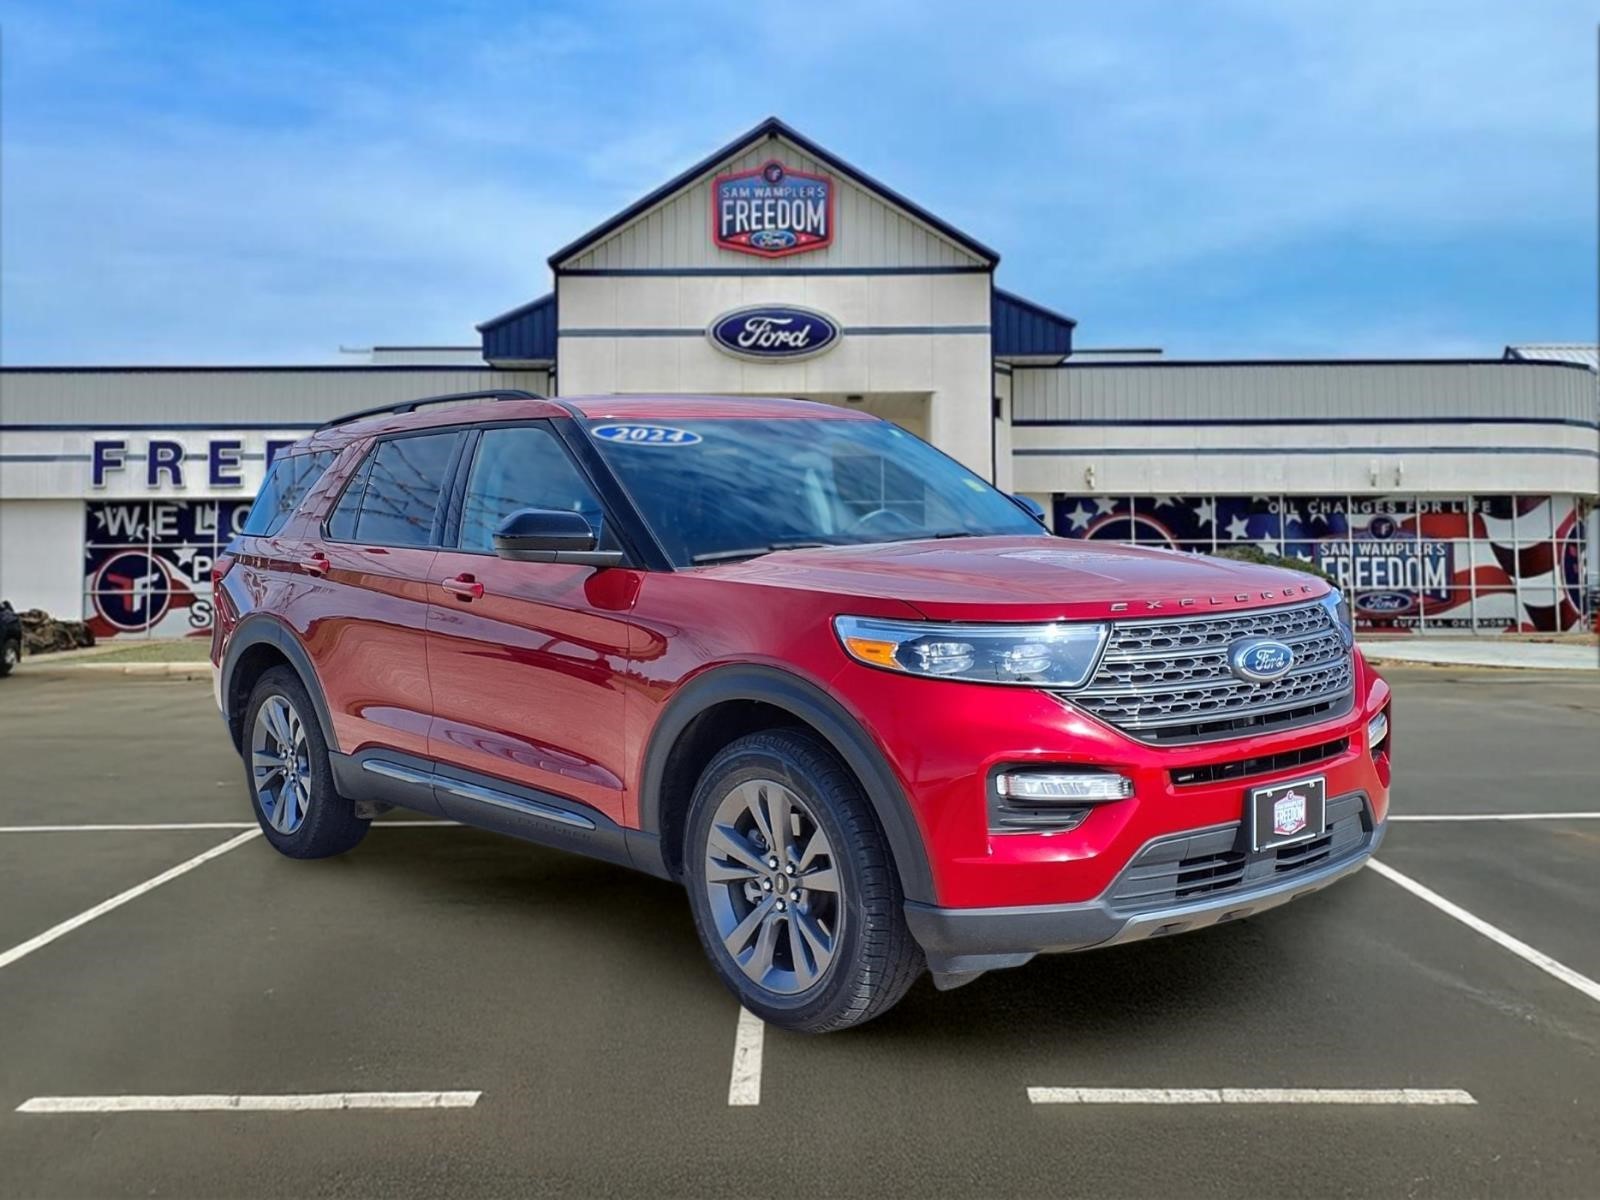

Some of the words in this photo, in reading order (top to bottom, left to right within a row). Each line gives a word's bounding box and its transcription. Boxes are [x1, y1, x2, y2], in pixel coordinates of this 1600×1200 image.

[722, 187, 750, 198] SAM
[721, 200, 826, 236] FREEDOM
[738, 317, 811, 347] Ford
[611, 428, 684, 442] 2024
[1268, 502, 1299, 514] OIL
[1307, 502, 1397, 514] CHANGES
[1405, 502, 1443, 514] FOR
[1451, 501, 1492, 514] LIFE
[1321, 557, 1447, 598] FREEDOM
[1110, 586, 1313, 611] EXPLORER
[1366, 596, 1400, 609] Ford
[1255, 649, 1284, 670] Ford
